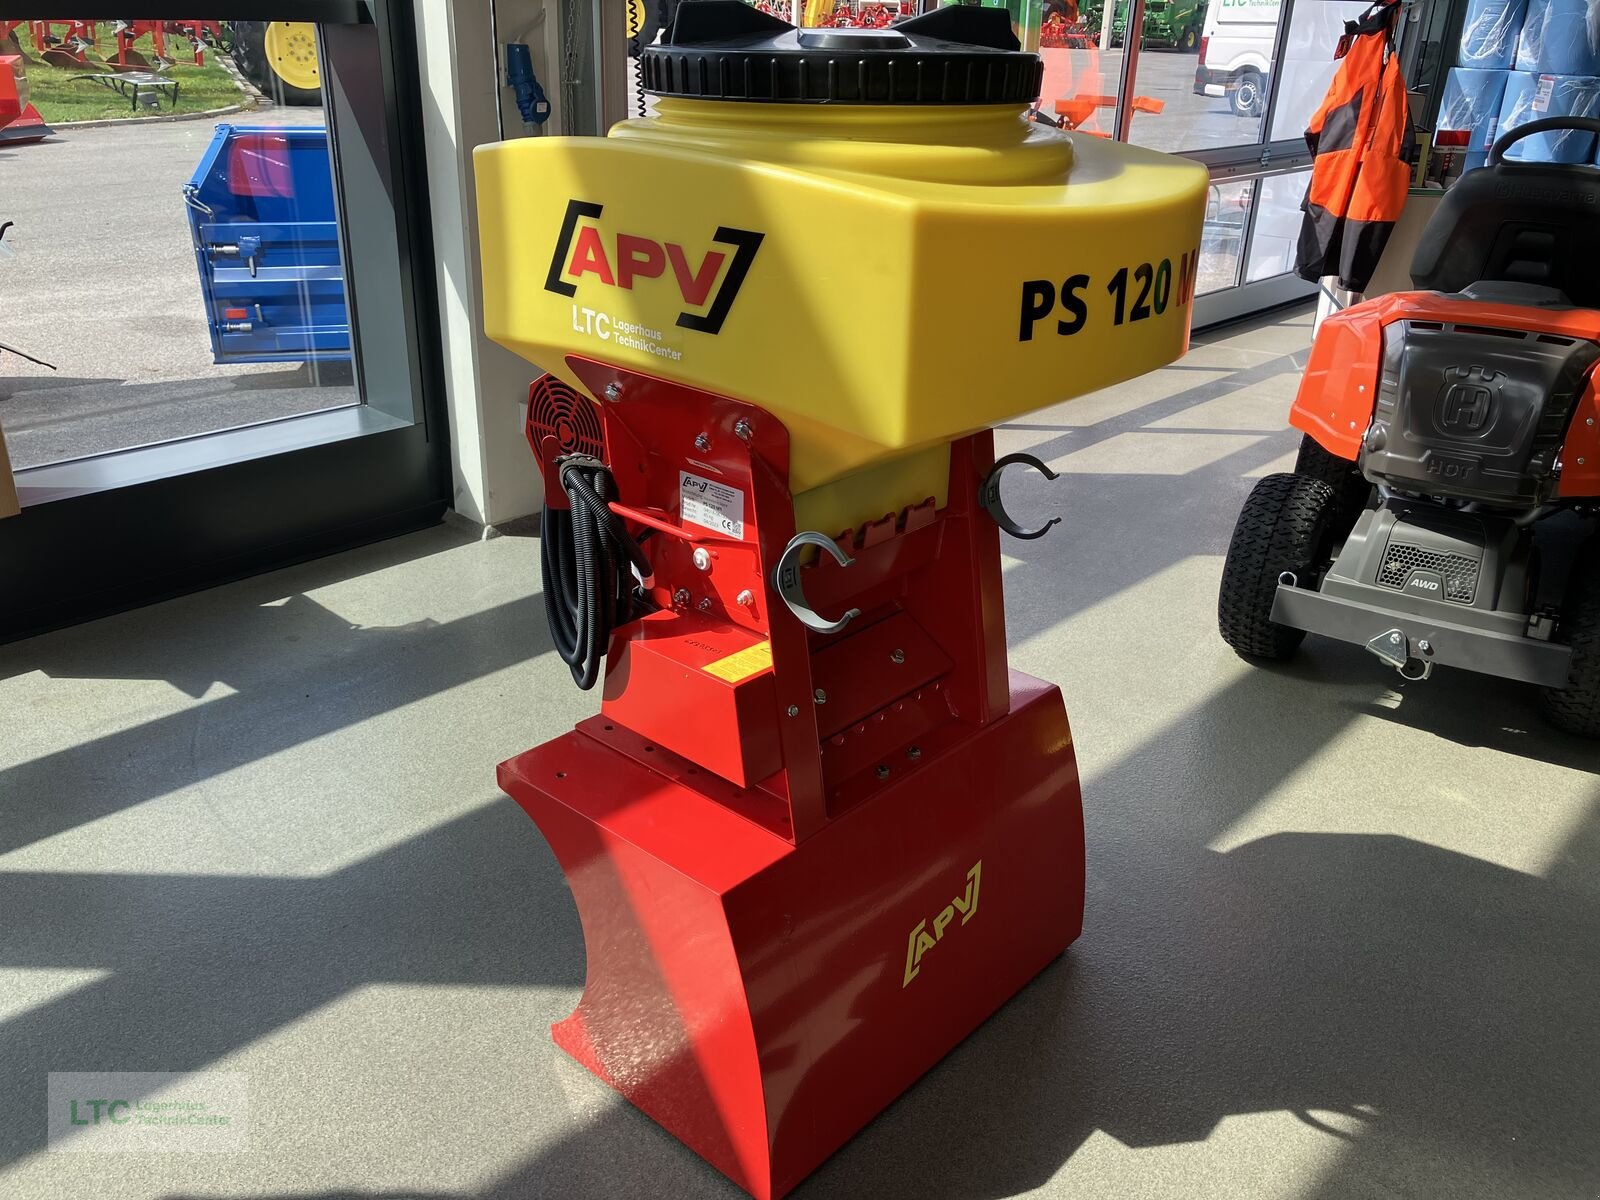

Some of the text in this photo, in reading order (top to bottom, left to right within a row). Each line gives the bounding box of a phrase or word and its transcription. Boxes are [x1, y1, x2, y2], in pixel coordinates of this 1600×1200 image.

[1019, 274, 1091, 342] PS
[1106, 258, 1172, 326] 120
[572, 304, 611, 341] LTC
[612, 316, 662, 341] Lagerhaus
[613, 331, 682, 361] TechnikCenter
[1426, 459, 1474, 480] HOT
[1410, 578, 1439, 591] AWD
